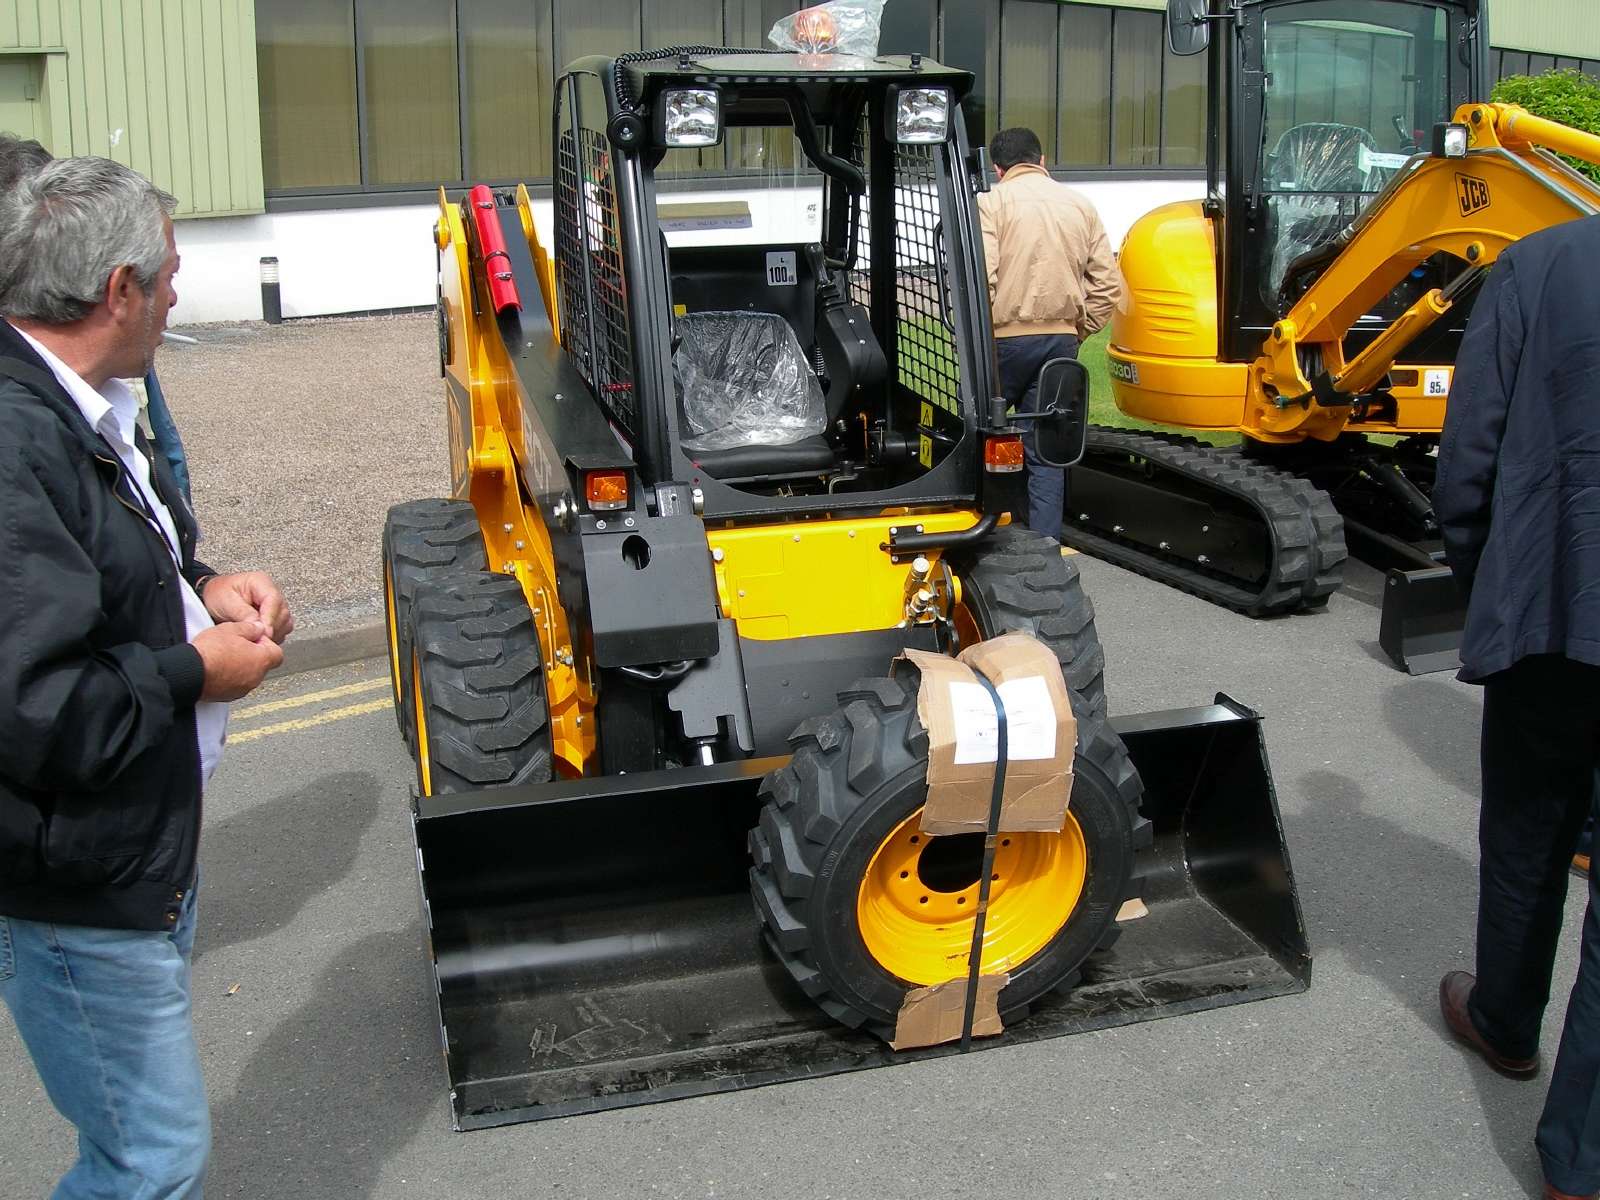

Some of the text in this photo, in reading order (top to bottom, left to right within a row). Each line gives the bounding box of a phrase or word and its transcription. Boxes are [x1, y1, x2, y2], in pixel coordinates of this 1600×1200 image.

[1460, 177, 1488, 212] JCB
[769, 266, 788, 283] 100
[1430, 381, 1441, 394] 95
